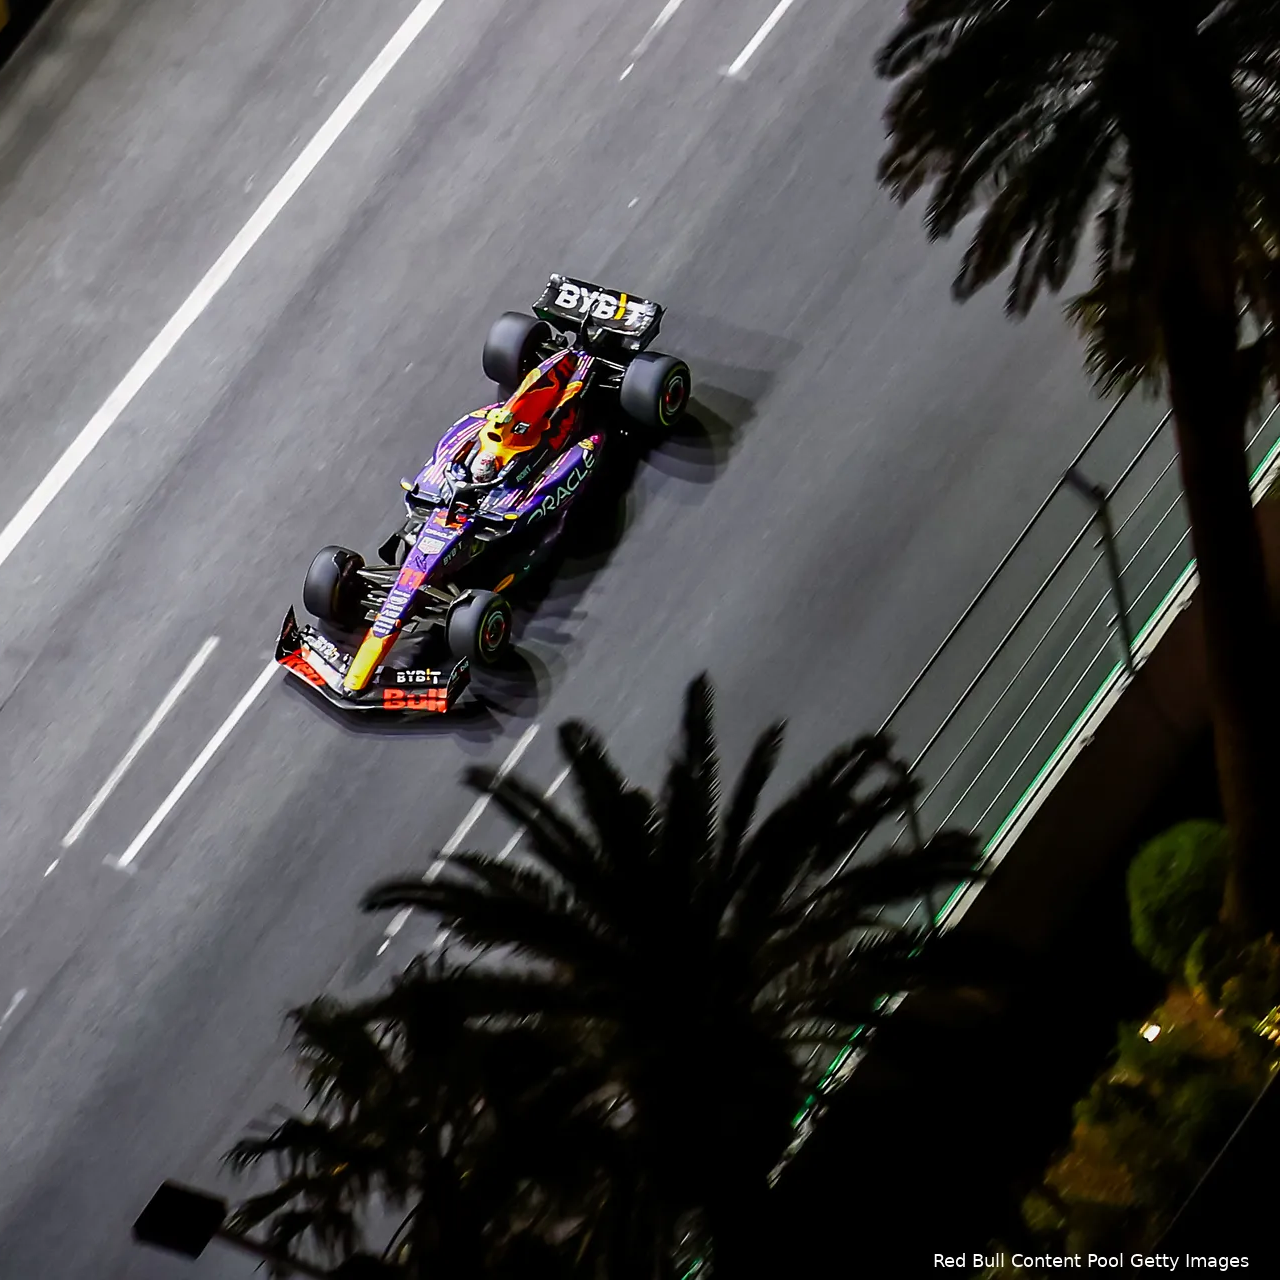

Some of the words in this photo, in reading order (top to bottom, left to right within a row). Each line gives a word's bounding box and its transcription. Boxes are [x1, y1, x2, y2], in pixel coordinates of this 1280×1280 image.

[554, 282, 647, 326] BYBIT
[526, 446, 597, 526] ORACLE
[396, 669, 441, 685] BYBIT
[383, 688, 449, 714] Bull
